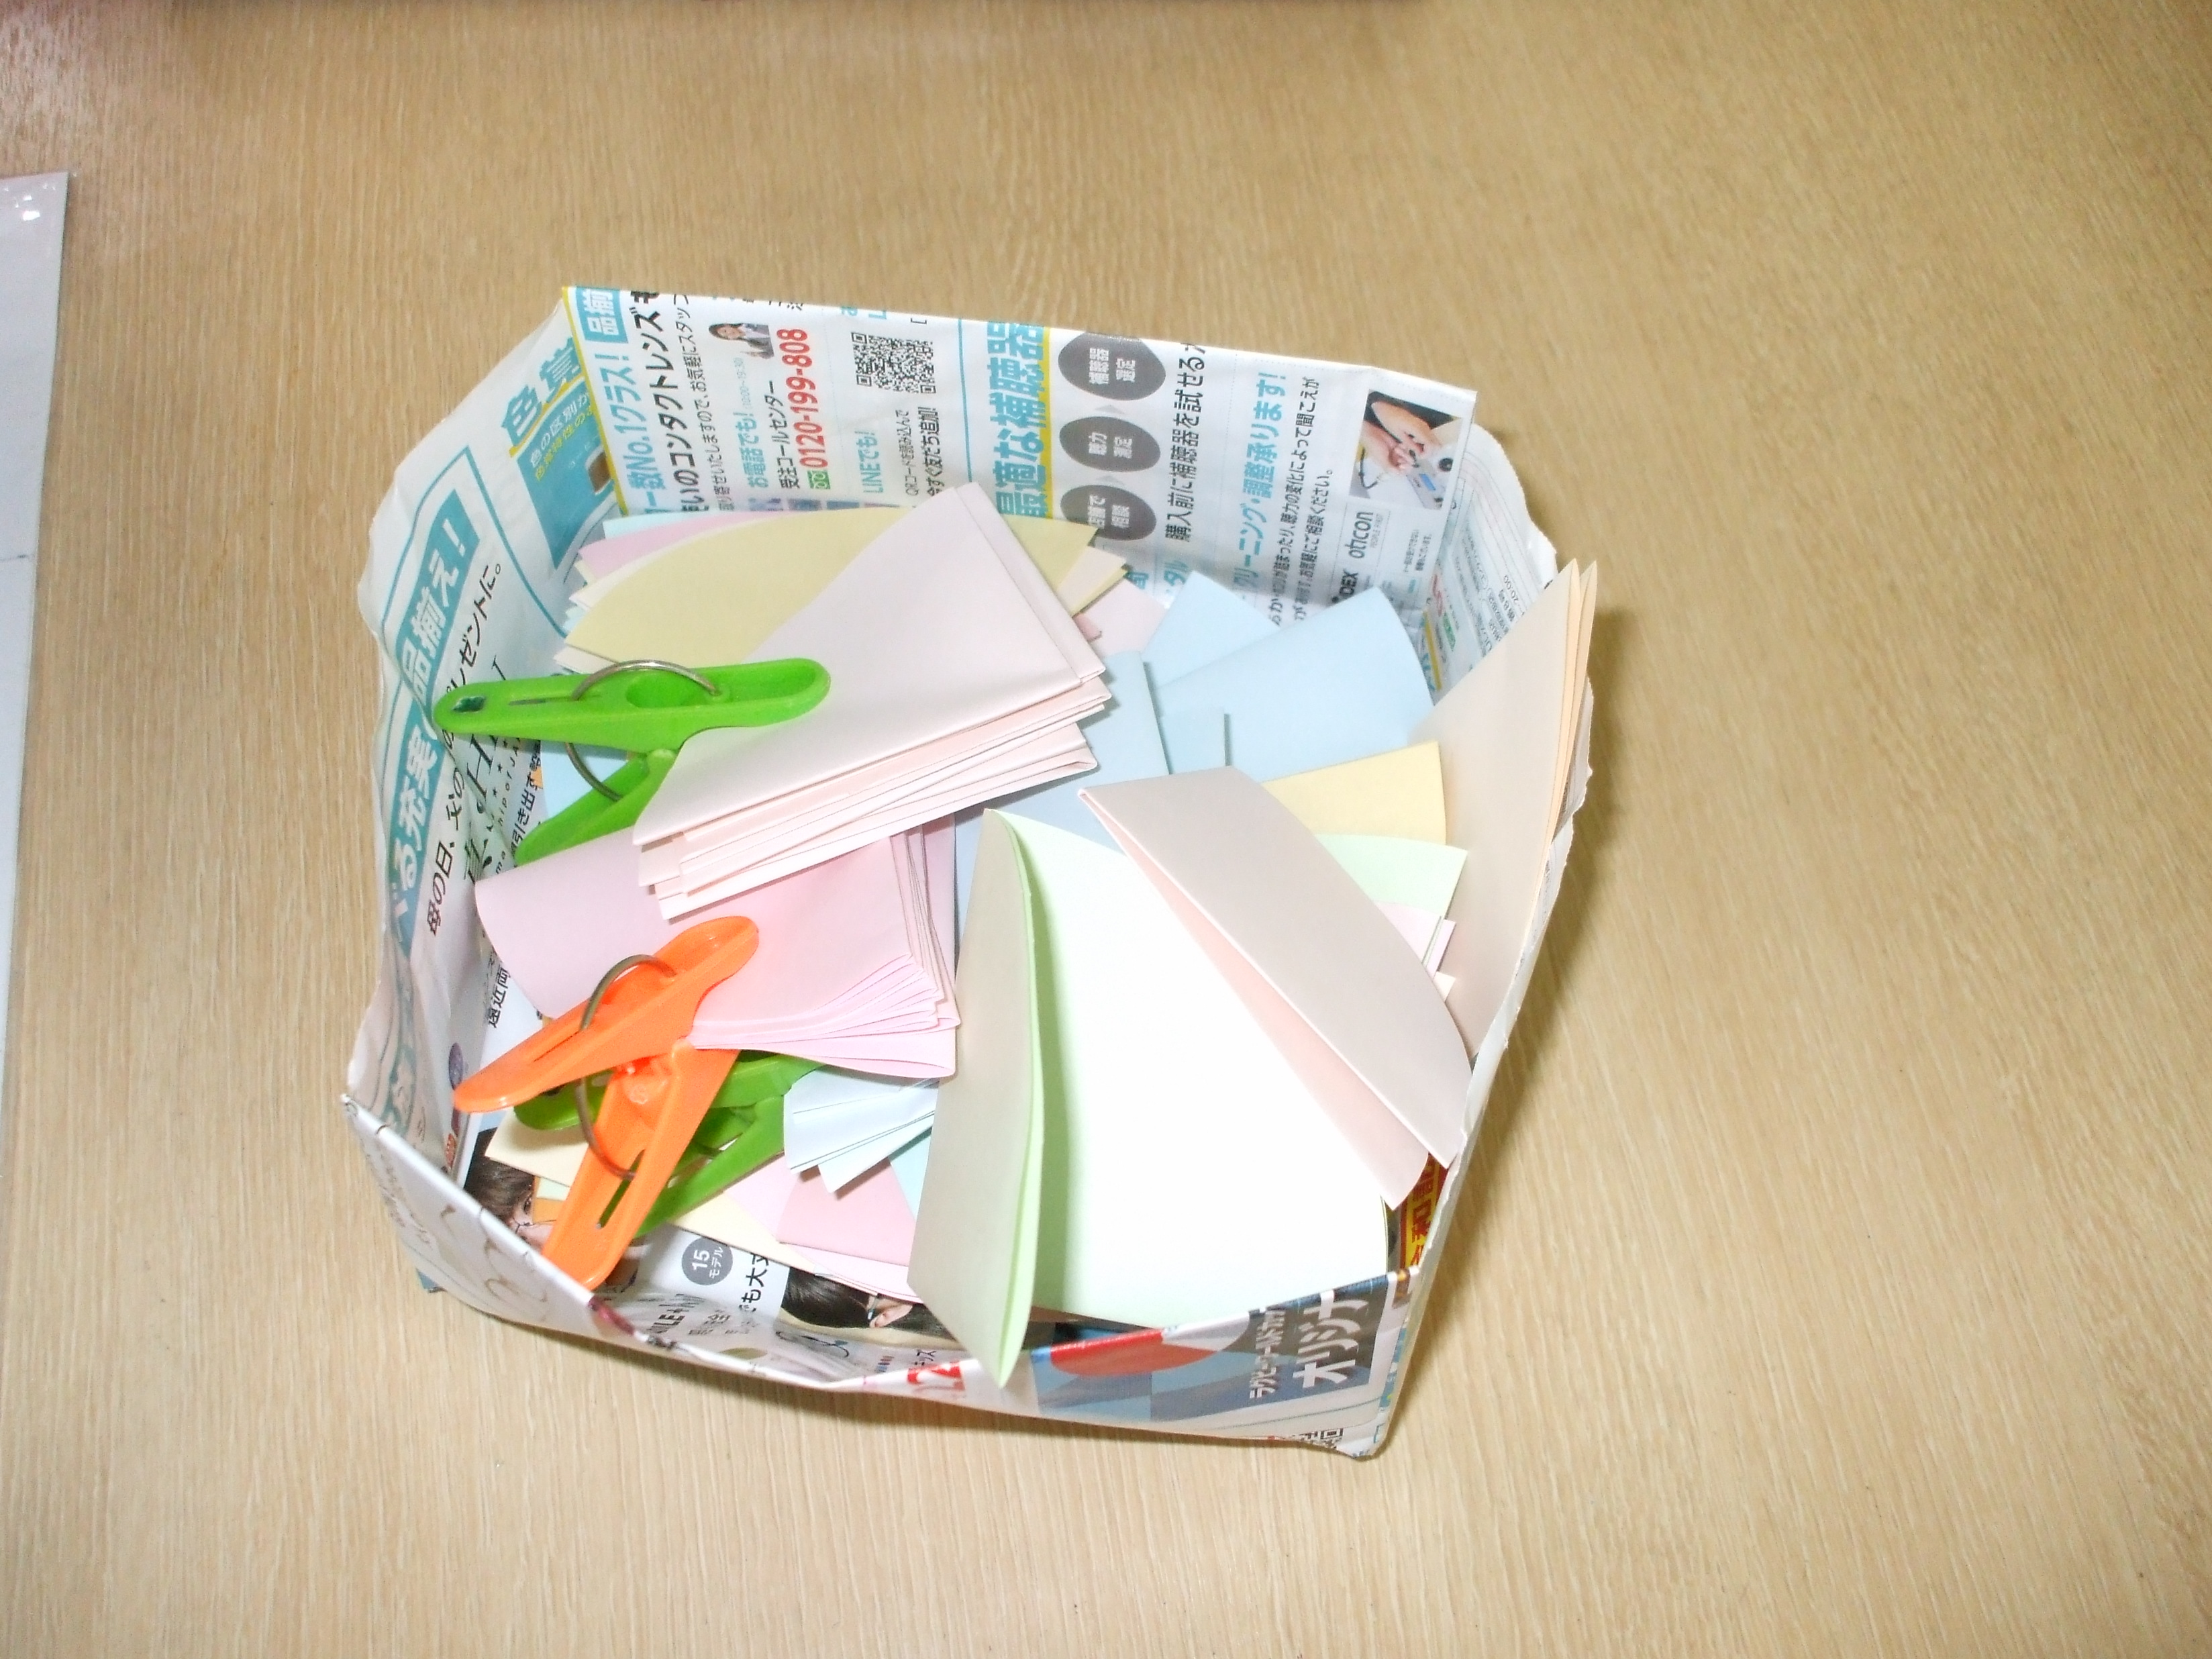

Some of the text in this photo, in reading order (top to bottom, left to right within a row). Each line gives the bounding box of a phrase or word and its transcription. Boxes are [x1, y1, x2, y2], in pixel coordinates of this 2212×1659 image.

[1089, 347, 1110, 386] 補聴器
[1115, 357, 1136, 383] 選定
[776, 328, 829, 468] 0120-199-808
[987, 322, 1048, 517] 最適な補聴器
[732, 411, 769, 489] お電話でも！
[764, 380, 801, 489] 受注コールセンター
[1088, 433, 1108, 455] 聴力
[1113, 434, 1133, 459] 測定
[853, 430, 884, 493] LINEでも！
[1348, 510, 1374, 559] oticon
[691, 1249, 711, 1271] 15
[709, 1246, 723, 1279] モデル
